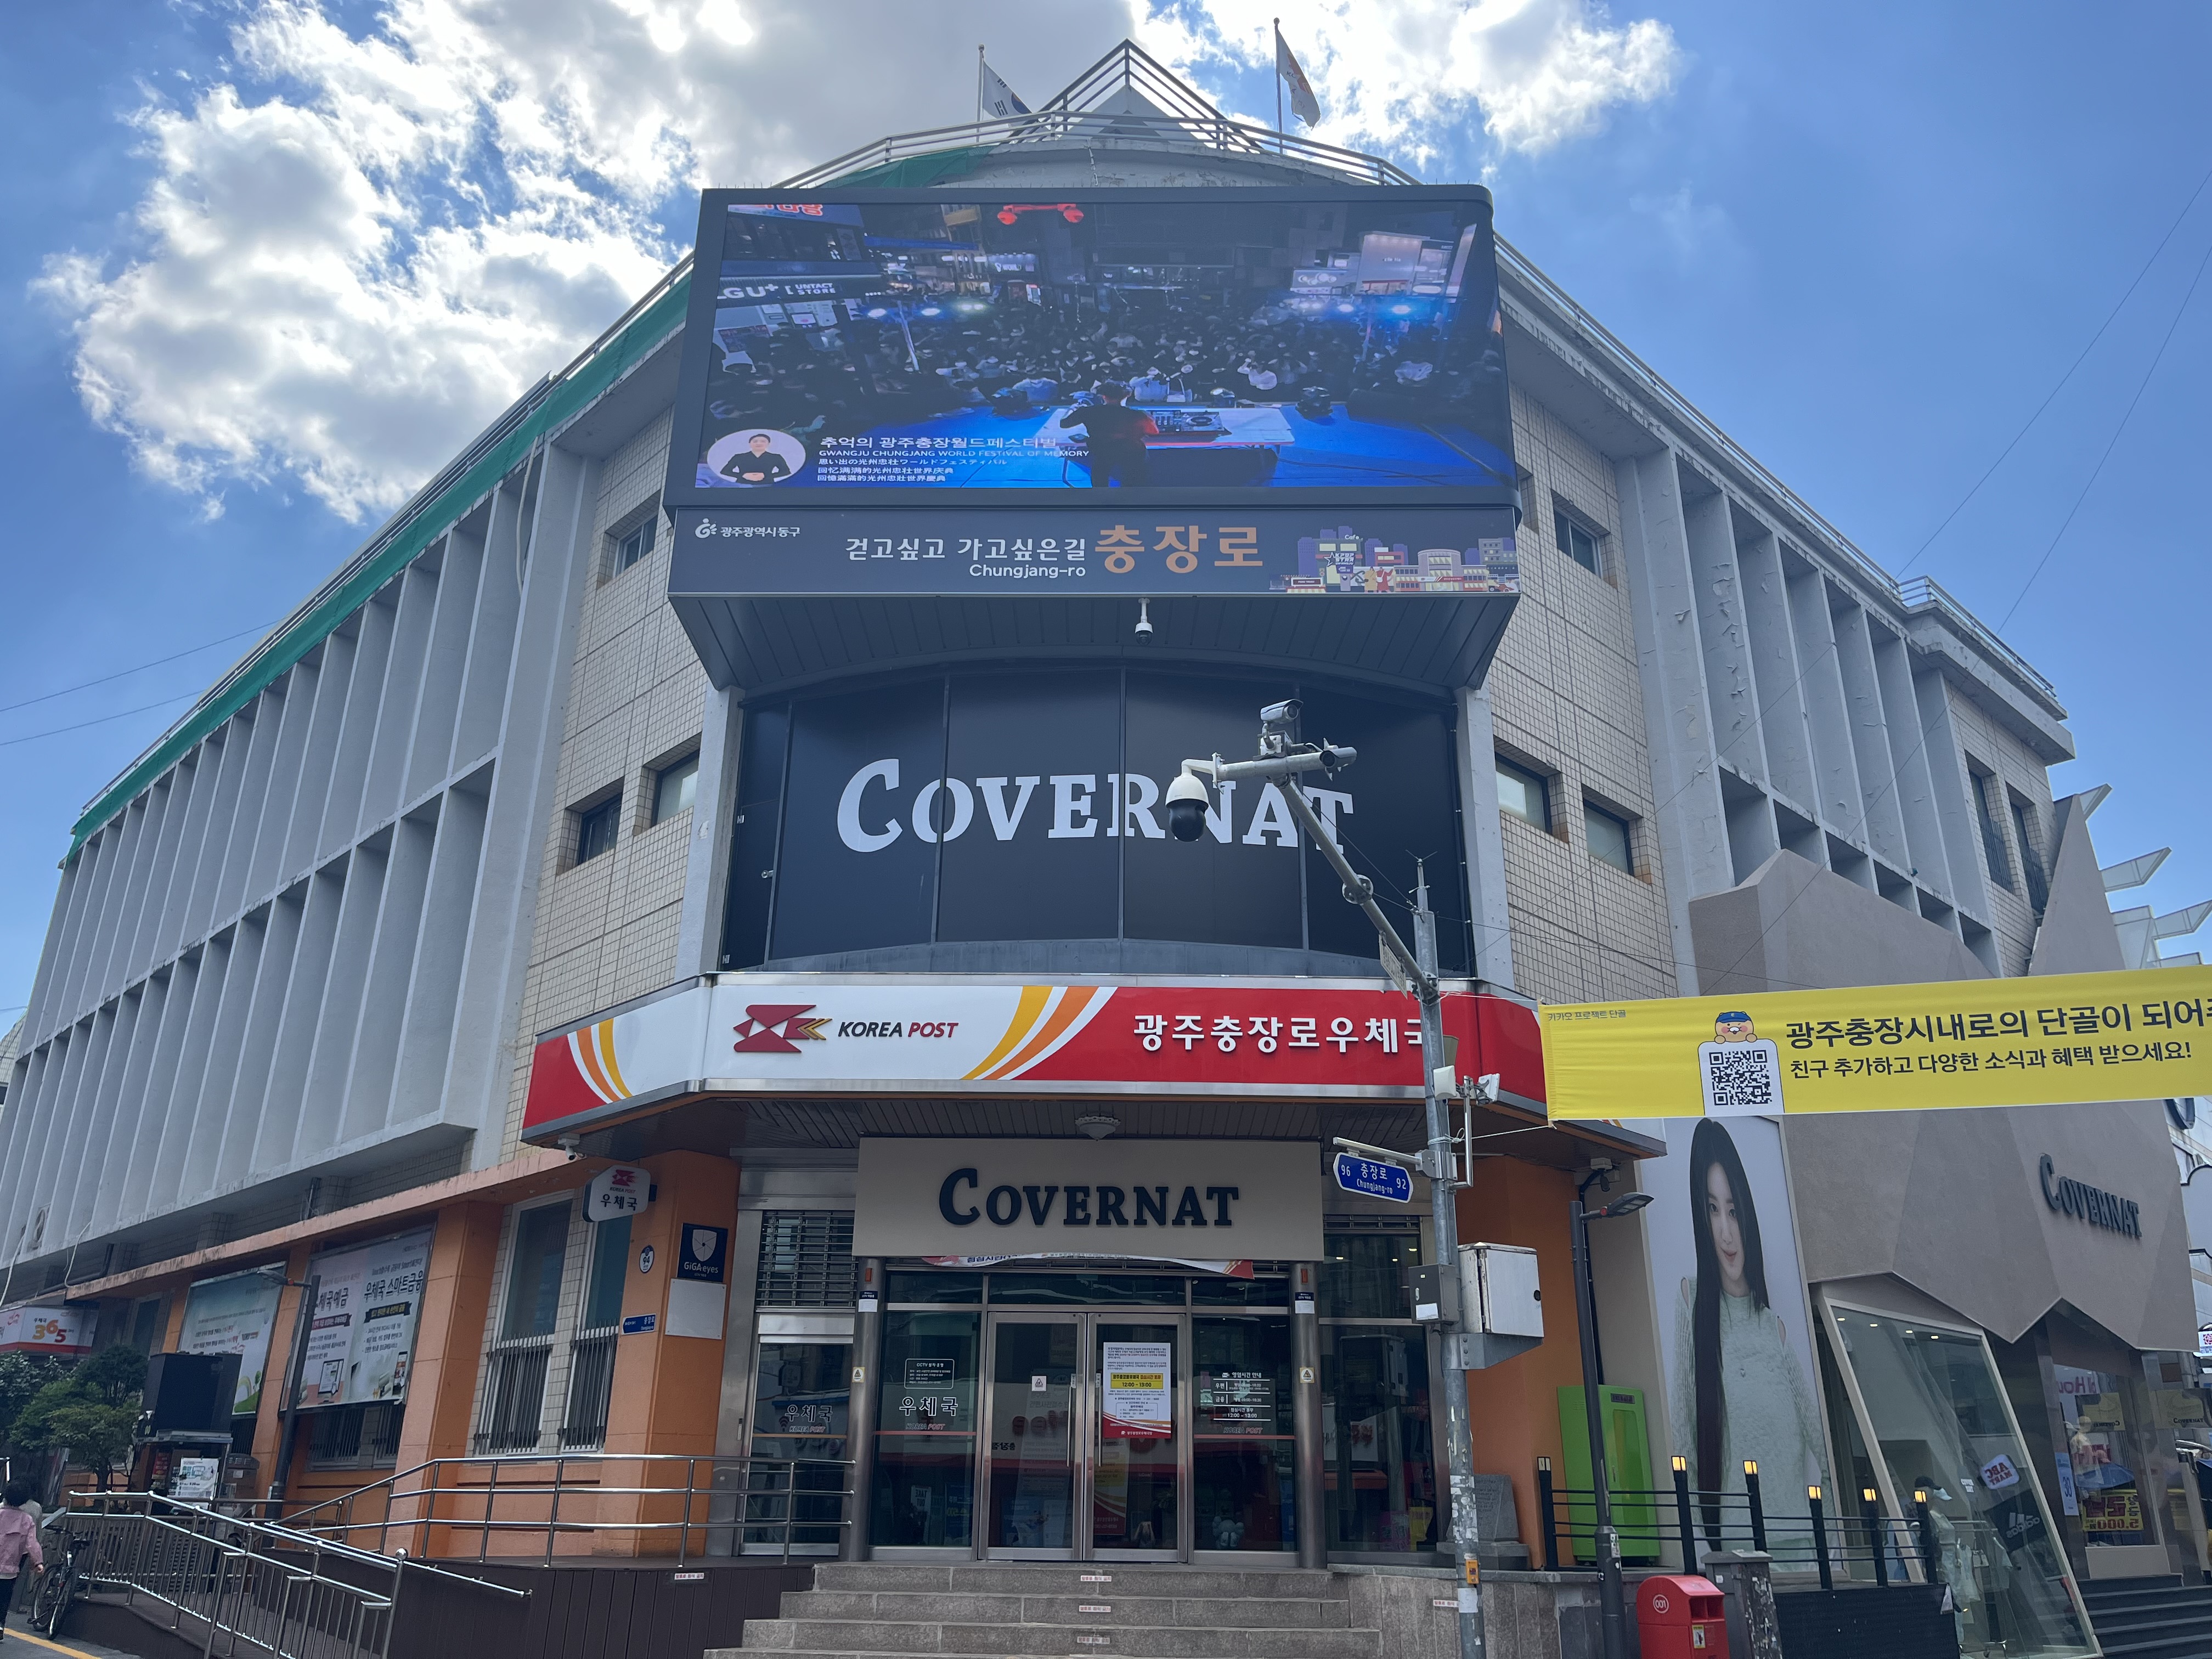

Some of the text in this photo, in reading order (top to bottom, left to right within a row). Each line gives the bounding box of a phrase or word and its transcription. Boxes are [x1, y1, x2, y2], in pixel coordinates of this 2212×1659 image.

[820, 437, 1056, 448] 추억의 광주충장월드페스티벌
[720, 526, 800, 538] 광주광역시동구
[845, 524, 1263, 574] 걷고싶고 가고싶은길 충장로
[969, 564, 1086, 579] Chungjang-ro
[1575, 1011, 1608, 1020] 프로젝트
[1609, 1009, 1626, 1018] 단골
[838, 1022, 958, 1038] KOREA POST
[1786, 1010, 2029, 1049] 광주충장시내로의
[2037, 1003, 2132, 1036] 단골이
[1790, 1042, 2192, 1079] 친구 추가하고 다양한 소식과 혜택 받으세요!
[1341, 1165, 1351, 1177] 96
[1360, 1163, 1388, 1180] 충장로
[1357, 1178, 1393, 1194] Chungjang-ro
[1396, 1178, 1407, 1190] 92
[601, 1194, 637, 1211] 우체국
[939, 1168, 1239, 1227] COVERNAT
[2039, 1153, 2142, 1237] COVERNAT
[643, 1256, 650, 1265] 94
[364, 1279, 386, 1301] 우체국
[386, 1270, 424, 1295] 스마트금융
[317, 1287, 349, 1311] 체국예금
[32, 1319, 67, 1343] 365
[785, 1404, 833, 1422] 우체국
[899, 1397, 958, 1416] 우체국
[1655, 1599, 1667, 1609] 001
